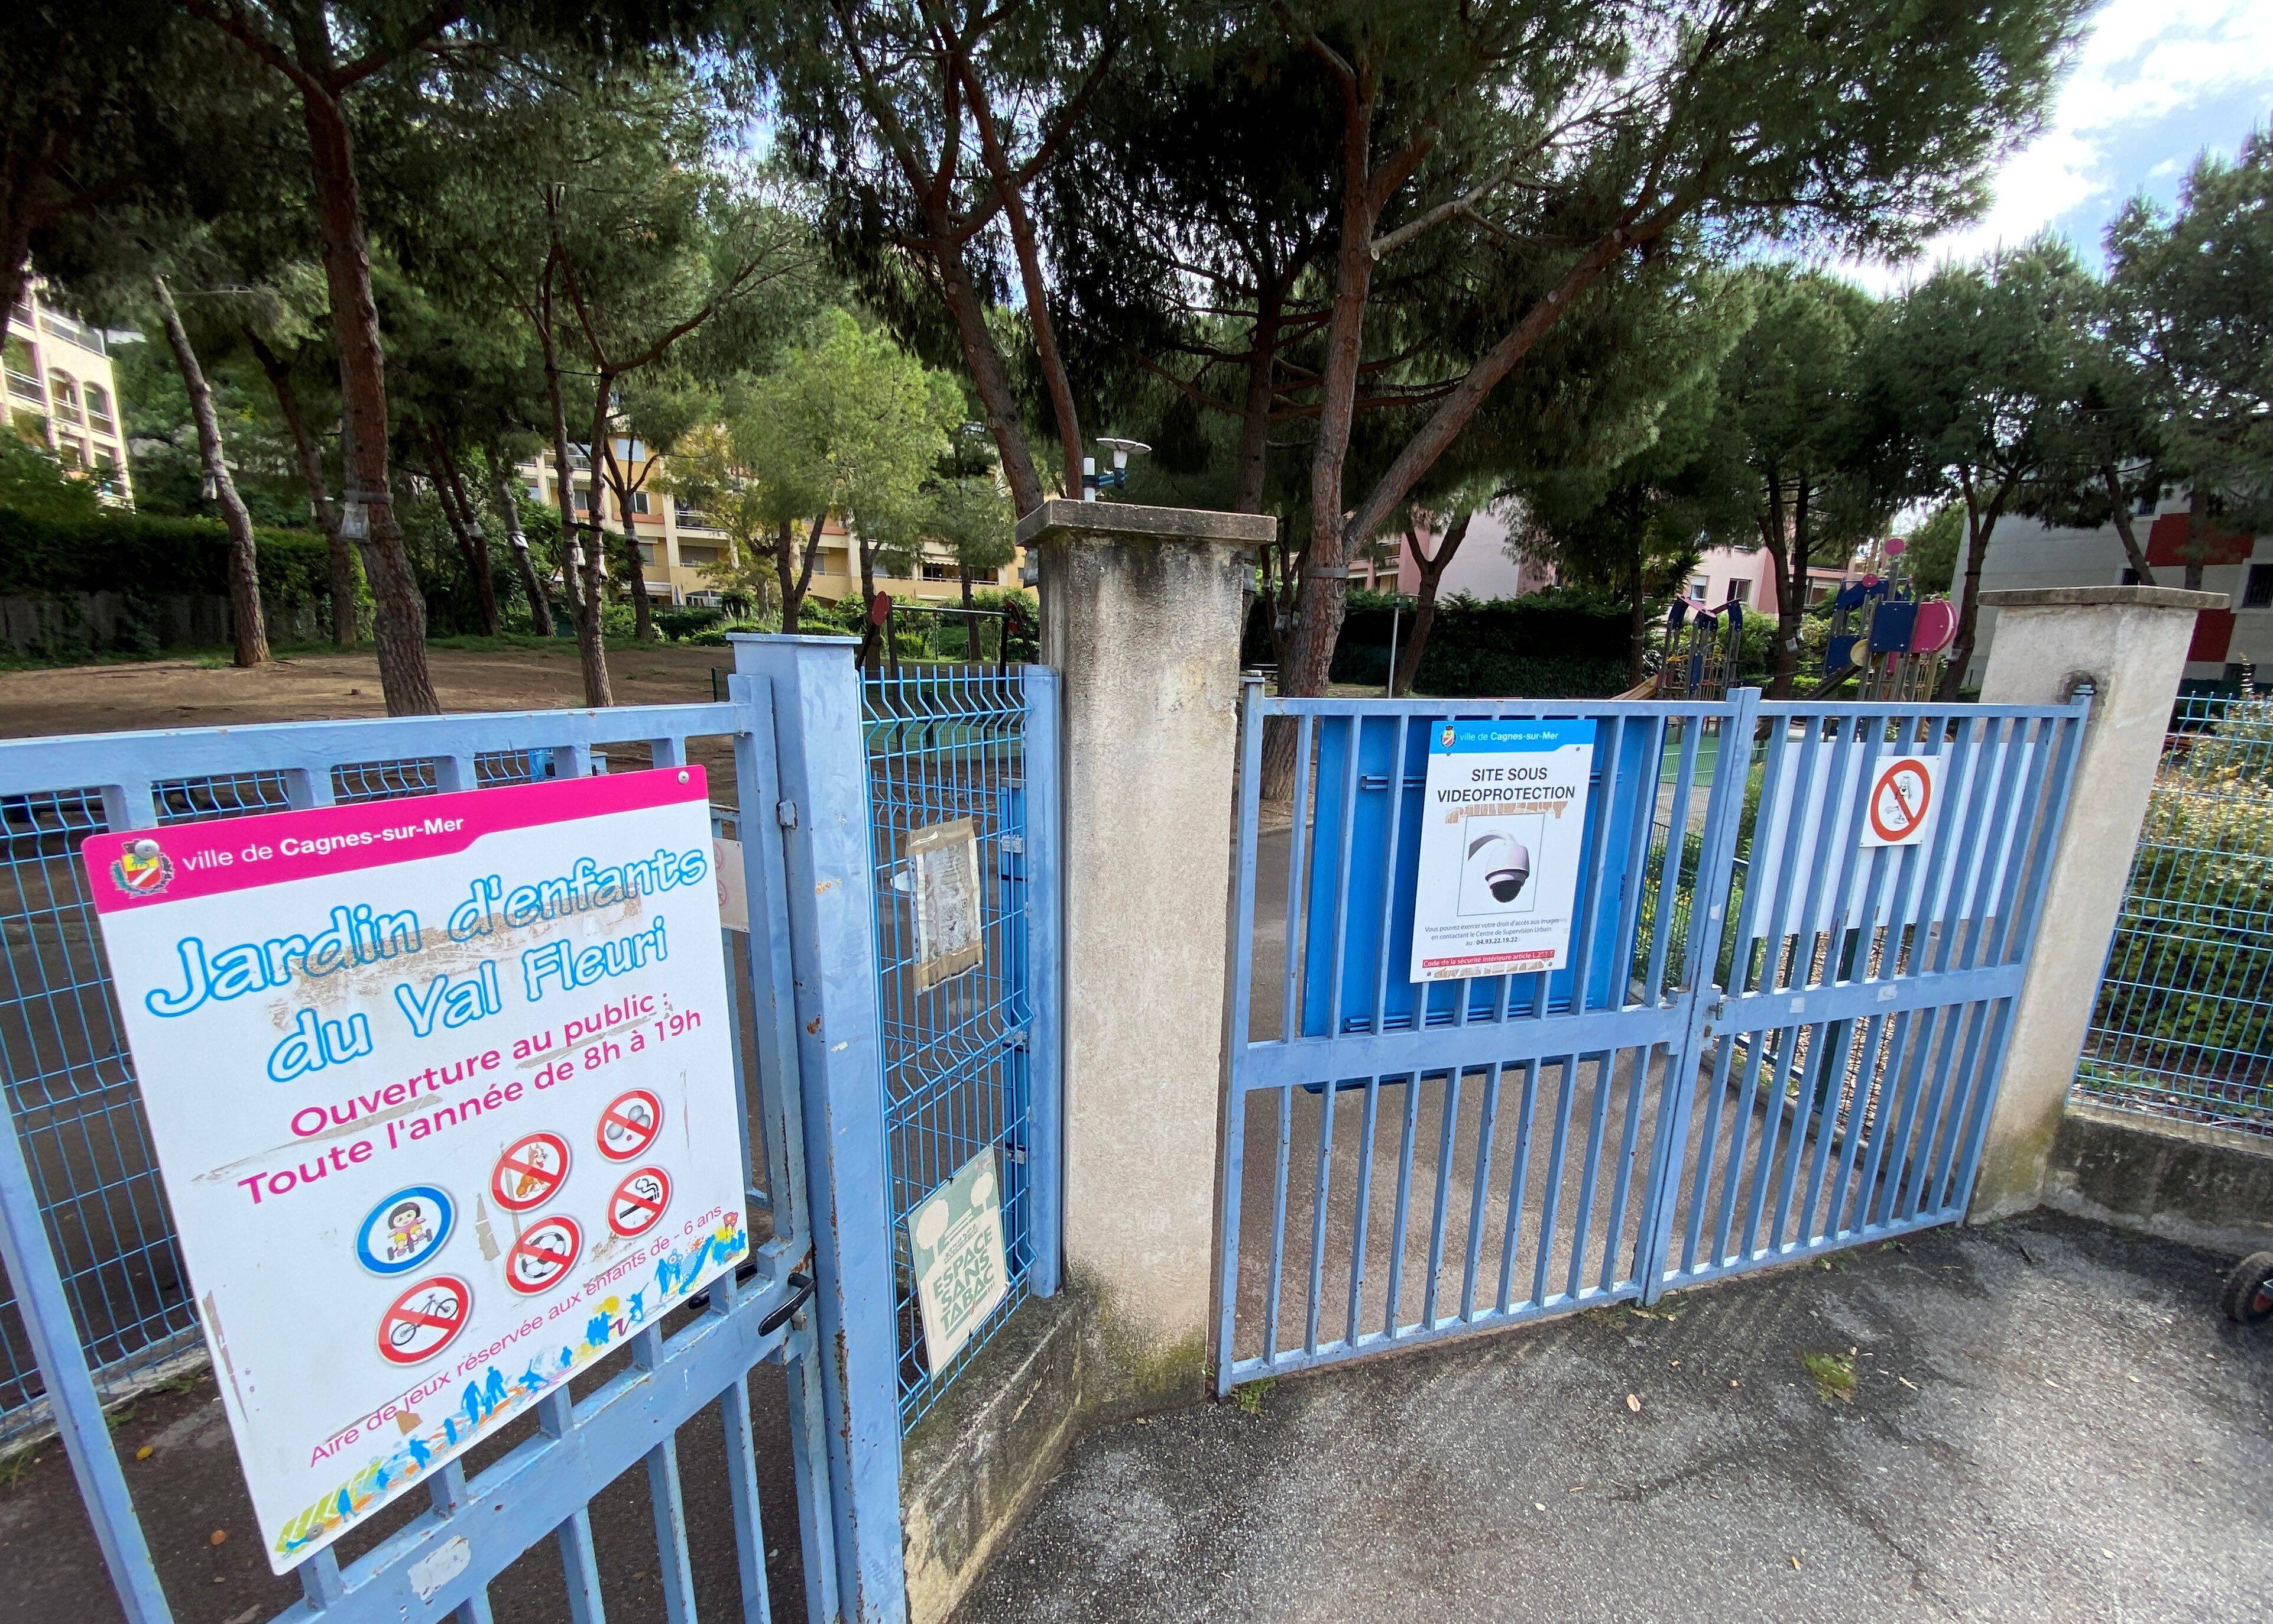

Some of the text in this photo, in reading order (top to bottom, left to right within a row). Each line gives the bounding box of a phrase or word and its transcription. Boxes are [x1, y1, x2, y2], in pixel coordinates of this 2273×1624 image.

[1460, 731, 1558, 741] ville de Cagnes-sur-Mer
[1438, 786, 1575, 802] VIDEOPROTECTION
[1471, 767, 1548, 782] SITE SOUS
[182, 817, 464, 871] ville de Cagnes-sur-Mer
[145, 844, 707, 1017] Jardin d'enfants
[1476, 937, 1518, 945] 04.93.22.19.22
[267, 916, 669, 1082] du Val Fleuri
[291, 1049, 502, 1137] Ouverture
[512, 1029, 552, 1060] au
[563, 993, 655, 1044] public
[238, 1010, 702, 1205] Toute l'année de 8h à 19h
[933, 1224, 993, 1300] ESPACE
[941, 1248, 990, 1313] SANS
[941, 1263, 994, 1332] TABAC
[309, 1427, 359, 1469] Aire
[365, 1403, 397, 1431] de
[403, 1370, 452, 1412] jeux
[456, 1317, 543, 1377] réservée
[548, 1291, 582, 1320] aux
[586, 1251, 647, 1296] enfants
[650, 1236, 670, 1257] de
[683, 1220, 693, 1236] 6
[697, 1205, 722, 1228] ans
